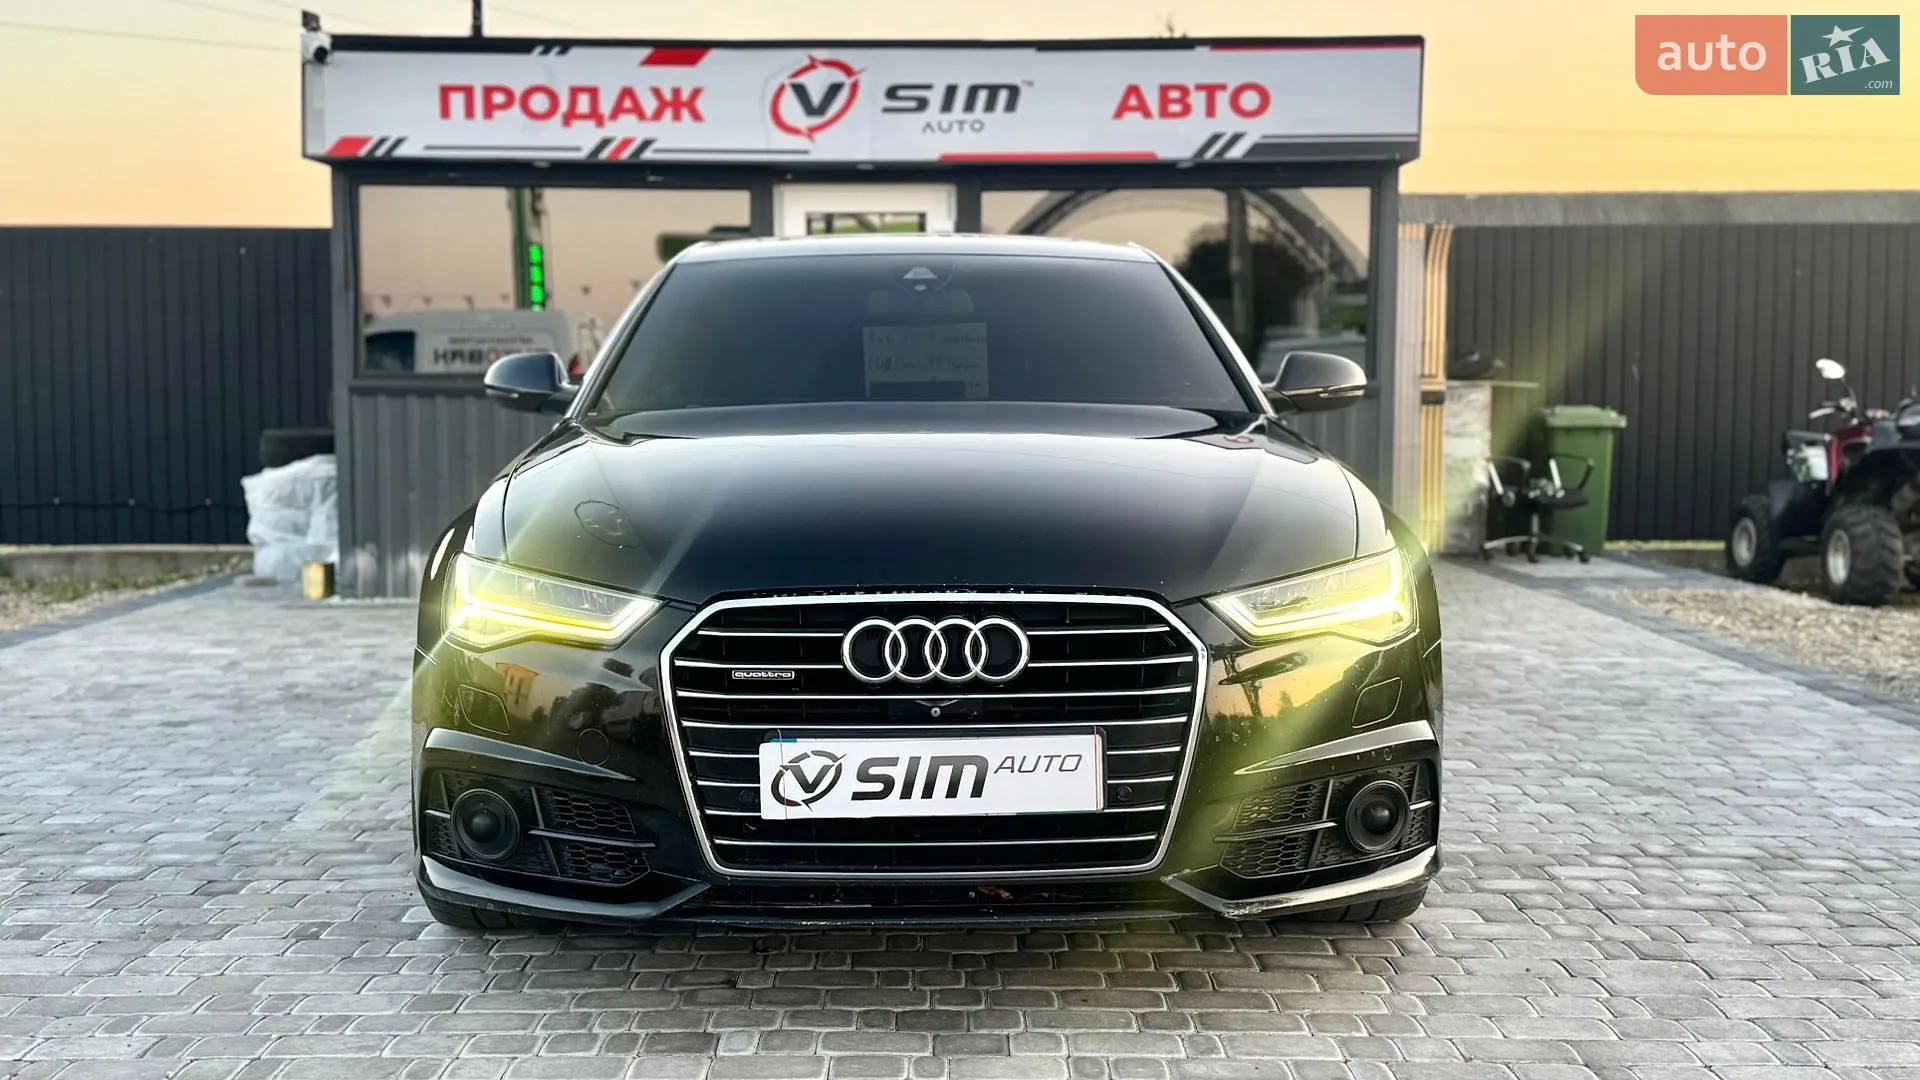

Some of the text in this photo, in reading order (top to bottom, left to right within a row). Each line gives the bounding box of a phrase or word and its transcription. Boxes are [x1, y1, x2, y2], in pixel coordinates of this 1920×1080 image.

[438, 84, 704, 128] ПРОДАЖ
[881, 83, 1021, 114] SIM
[1112, 82, 1272, 120] АВТО
[921, 119, 986, 134] AUTO
[734, 671, 791, 679] quattro
[850, 754, 989, 802] SIM
[993, 753, 1083, 775] AUTO
